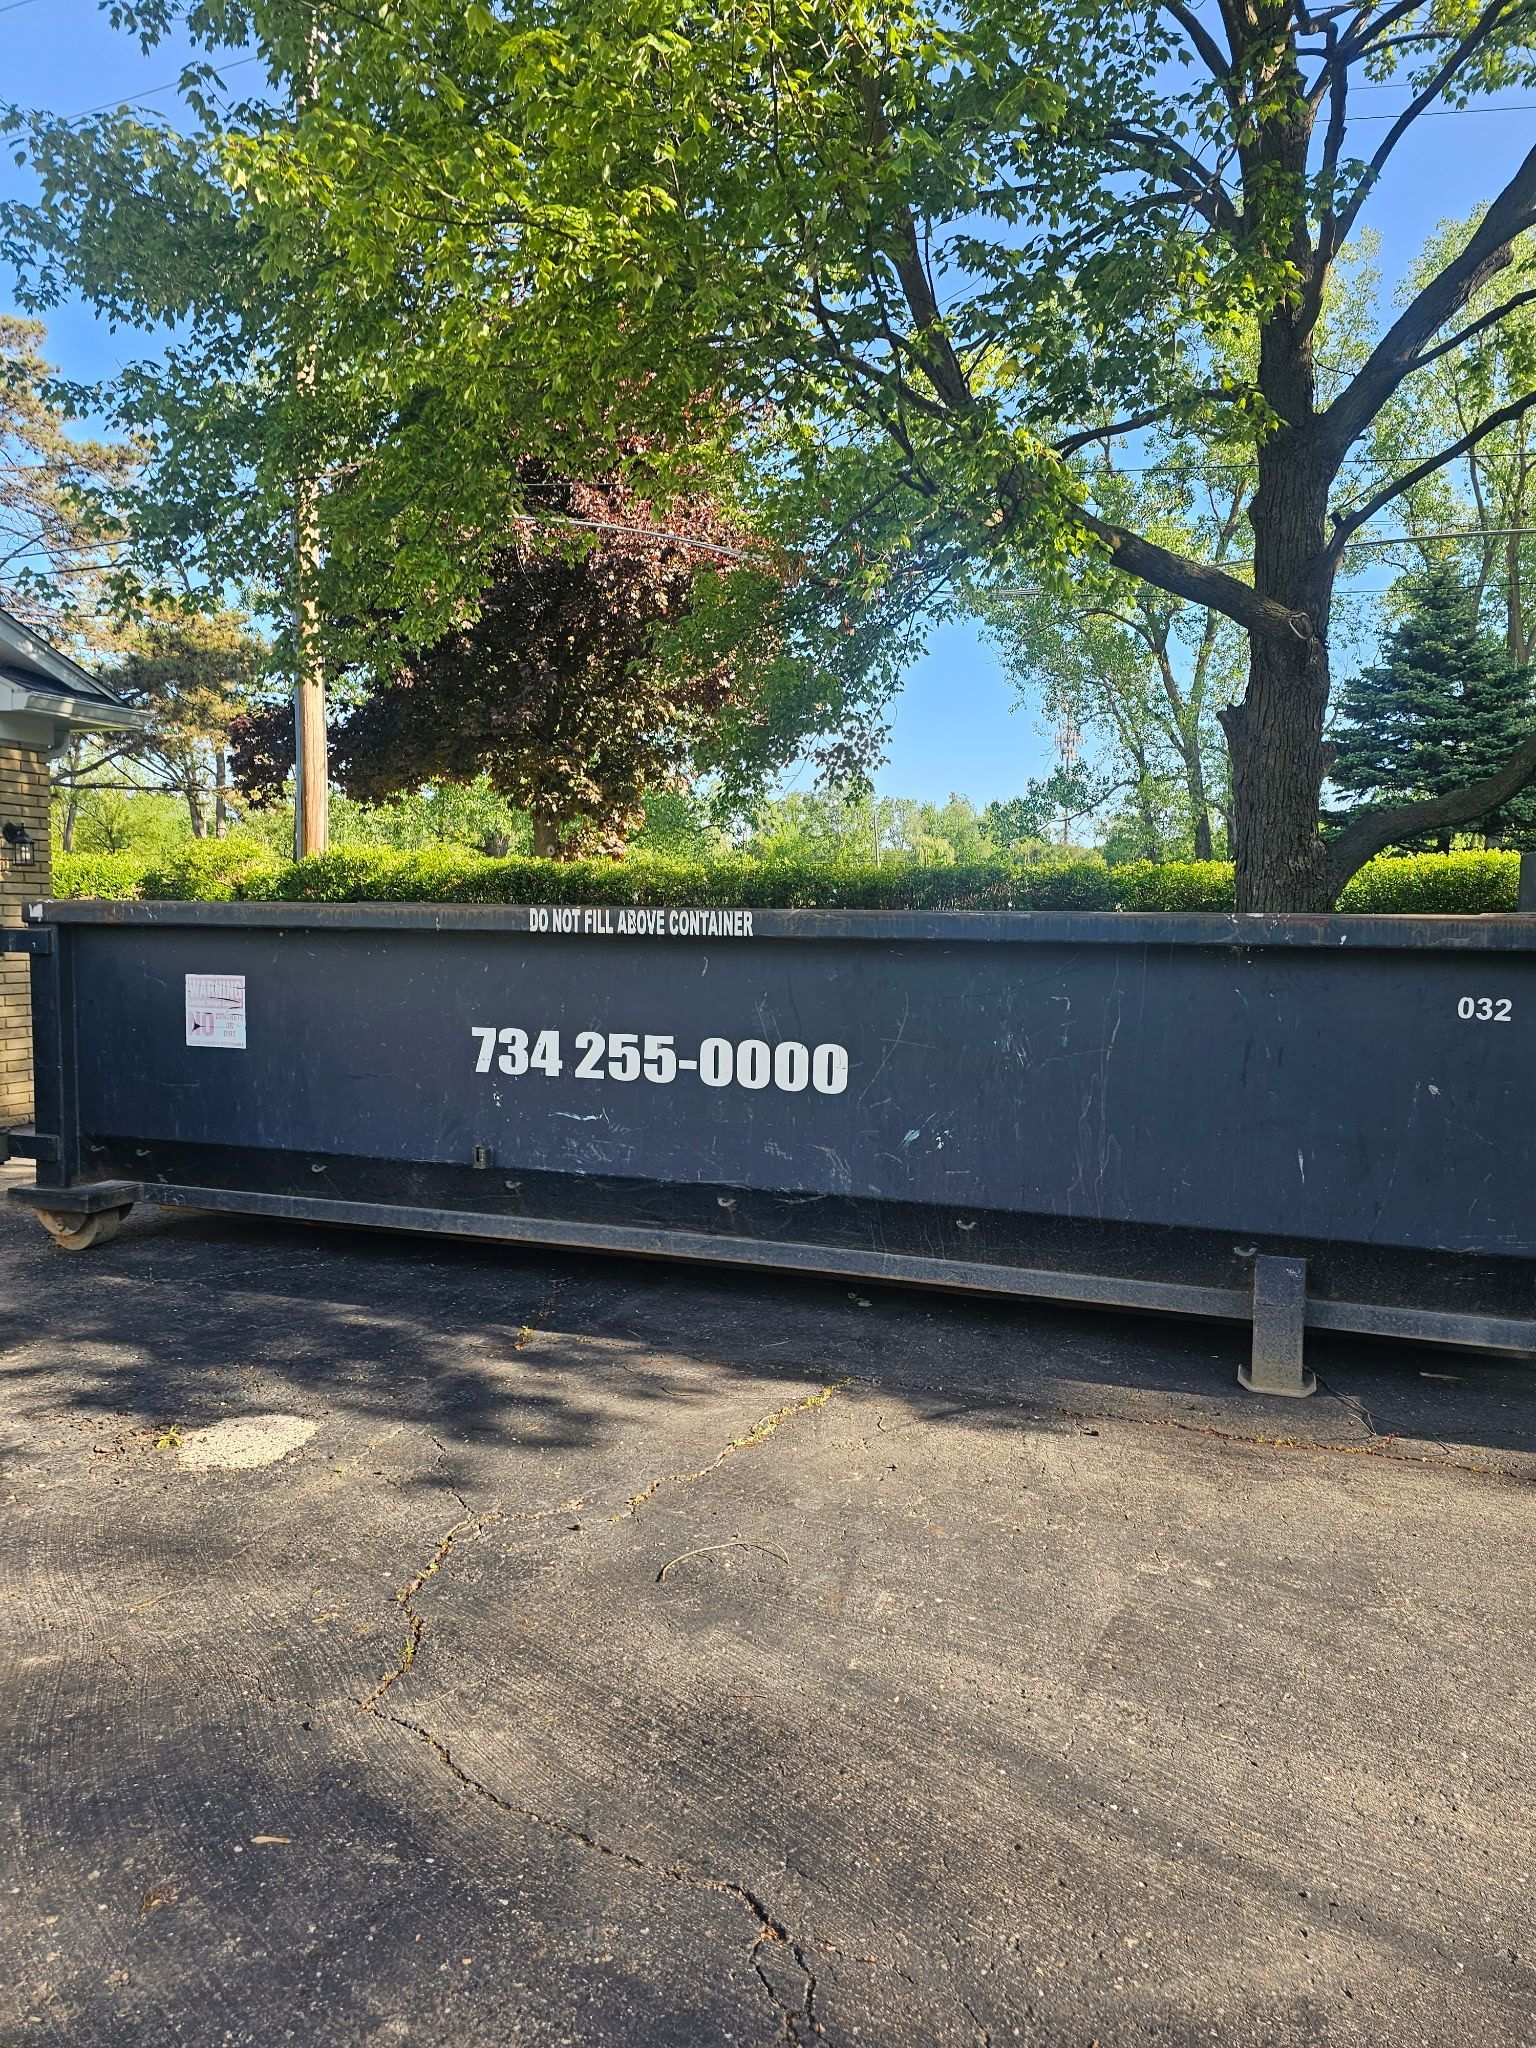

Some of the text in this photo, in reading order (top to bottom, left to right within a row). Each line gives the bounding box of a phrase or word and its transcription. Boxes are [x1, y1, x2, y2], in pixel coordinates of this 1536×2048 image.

[529, 908, 753, 937] DO NOT FILL ABOVE CONTAINER
[188, 979, 243, 1000] WARNING
[1457, 996, 1512, 1022] 032
[471, 1026, 849, 1095] 734 255-0000
